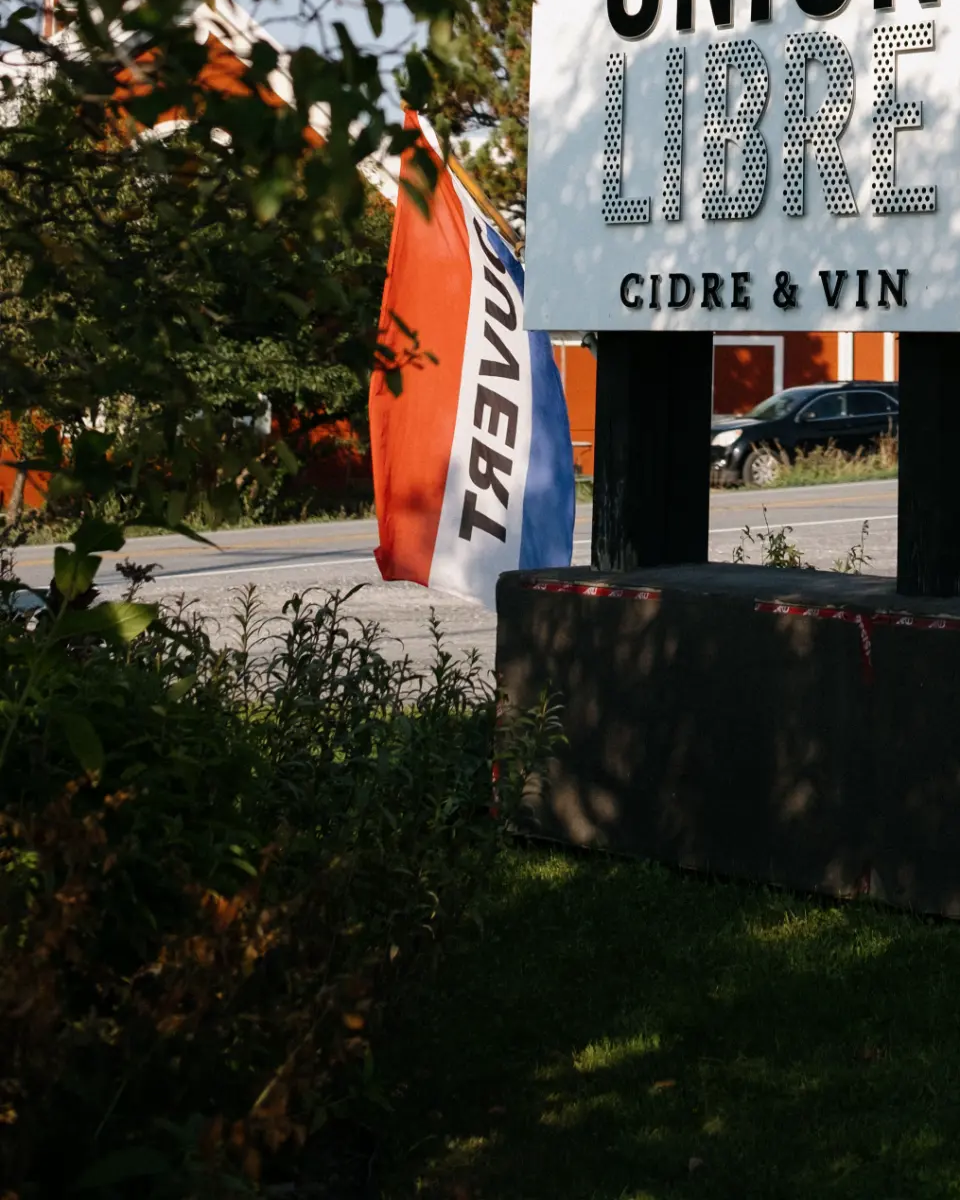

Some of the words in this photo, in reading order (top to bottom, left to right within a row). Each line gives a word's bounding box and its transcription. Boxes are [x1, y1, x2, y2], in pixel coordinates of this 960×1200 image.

[603, 20, 938, 224] LIBRE
[620, 272, 750, 309] CIDRE
[773, 271, 799, 310] &
[819, 269, 909, 307] VIN
